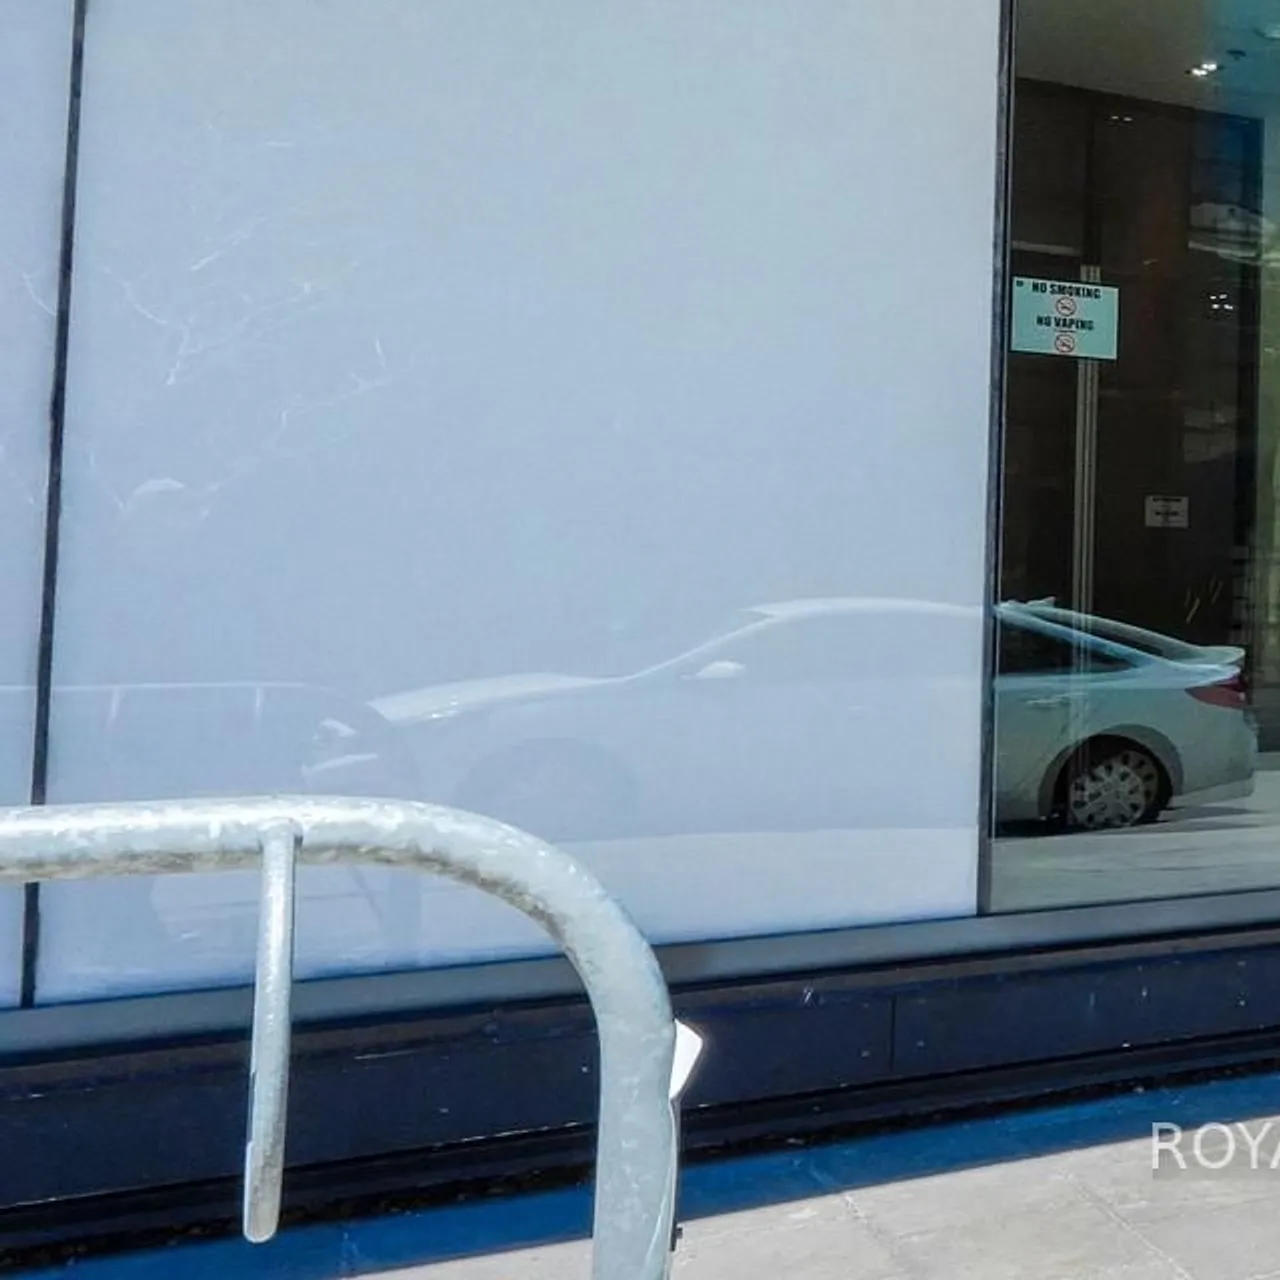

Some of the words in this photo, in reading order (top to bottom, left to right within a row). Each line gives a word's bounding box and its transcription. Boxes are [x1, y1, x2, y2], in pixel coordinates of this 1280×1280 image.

[1032, 281, 1047, 293] NO
[1050, 284, 1101, 299] SMOKING
[1036, 315, 1051, 327] NO
[1054, 316, 1094, 330] VAPING
